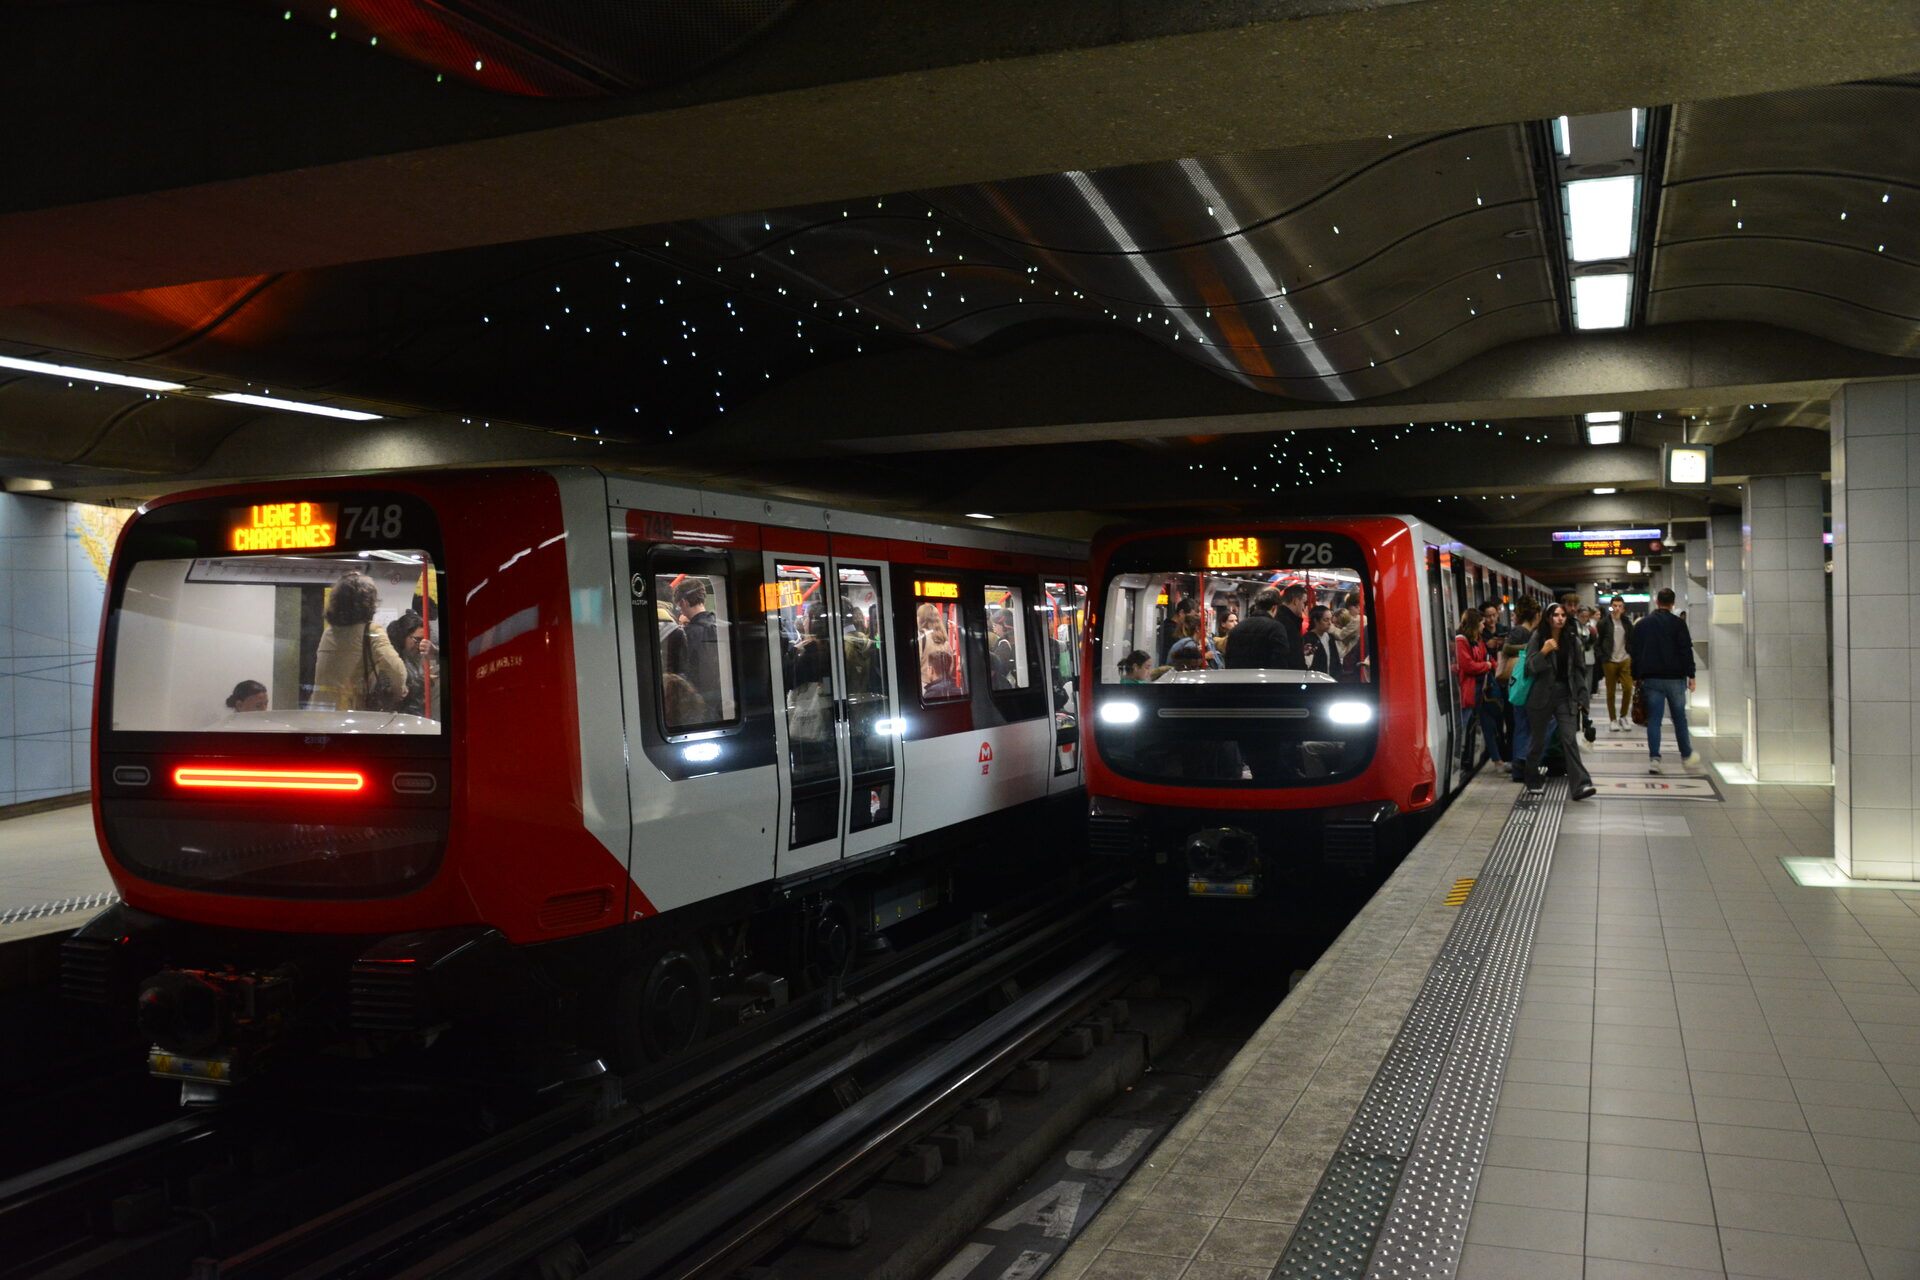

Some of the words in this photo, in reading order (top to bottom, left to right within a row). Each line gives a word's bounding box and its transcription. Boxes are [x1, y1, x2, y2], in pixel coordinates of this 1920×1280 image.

[253, 504, 296, 528] LIGNE
[300, 502, 312, 526] B
[344, 504, 403, 540] 748
[643, 514, 672, 540] 748
[234, 524, 331, 551] CHARPENNES
[1208, 537, 1244, 554] LIGNE
[1247, 537, 1257, 554] B
[1207, 551, 1260, 568] OULLINS
[1284, 543, 1334, 566] 726
